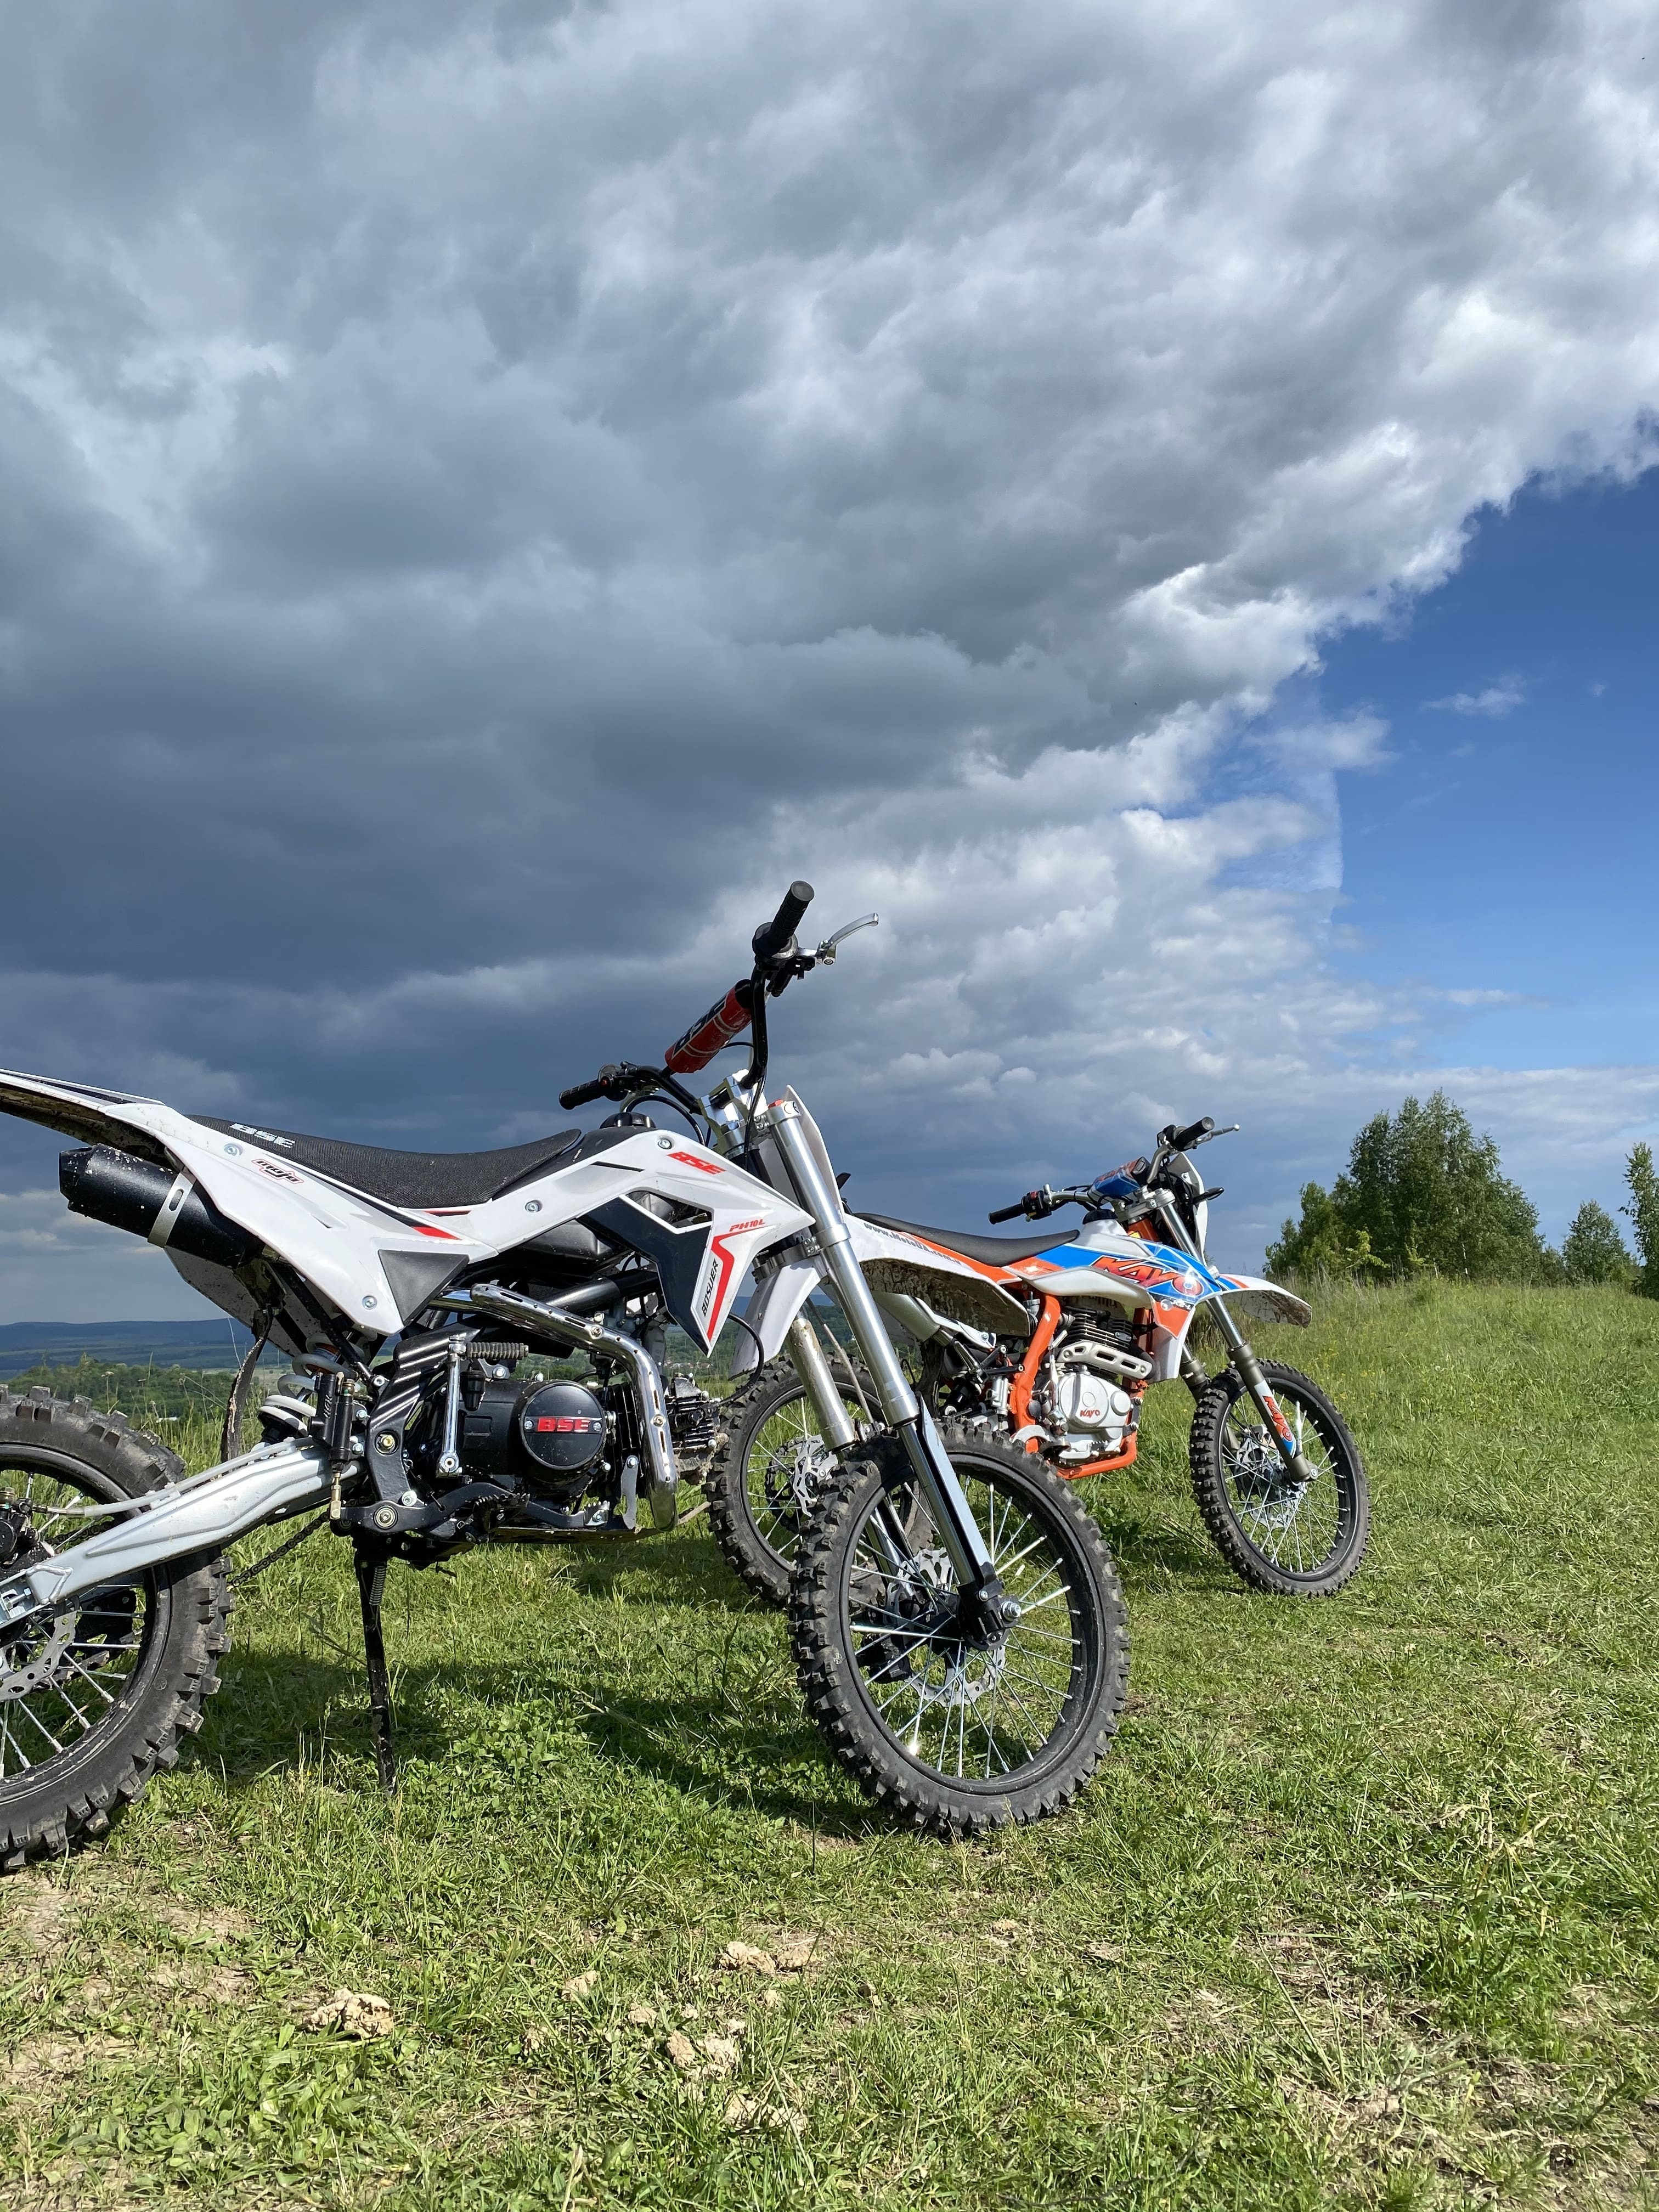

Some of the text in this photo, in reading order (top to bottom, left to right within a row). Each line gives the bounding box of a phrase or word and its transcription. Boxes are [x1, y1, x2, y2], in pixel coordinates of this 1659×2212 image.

[229, 1123, 295, 1149] BSE
[667, 1151, 727, 1175] BSE
[1092, 1256, 1204, 1296] KAYO
[538, 1418, 590, 1432] BSE
[1080, 1408, 1101, 1418] KAYO
[1262, 1395, 1293, 1441] KAYO
